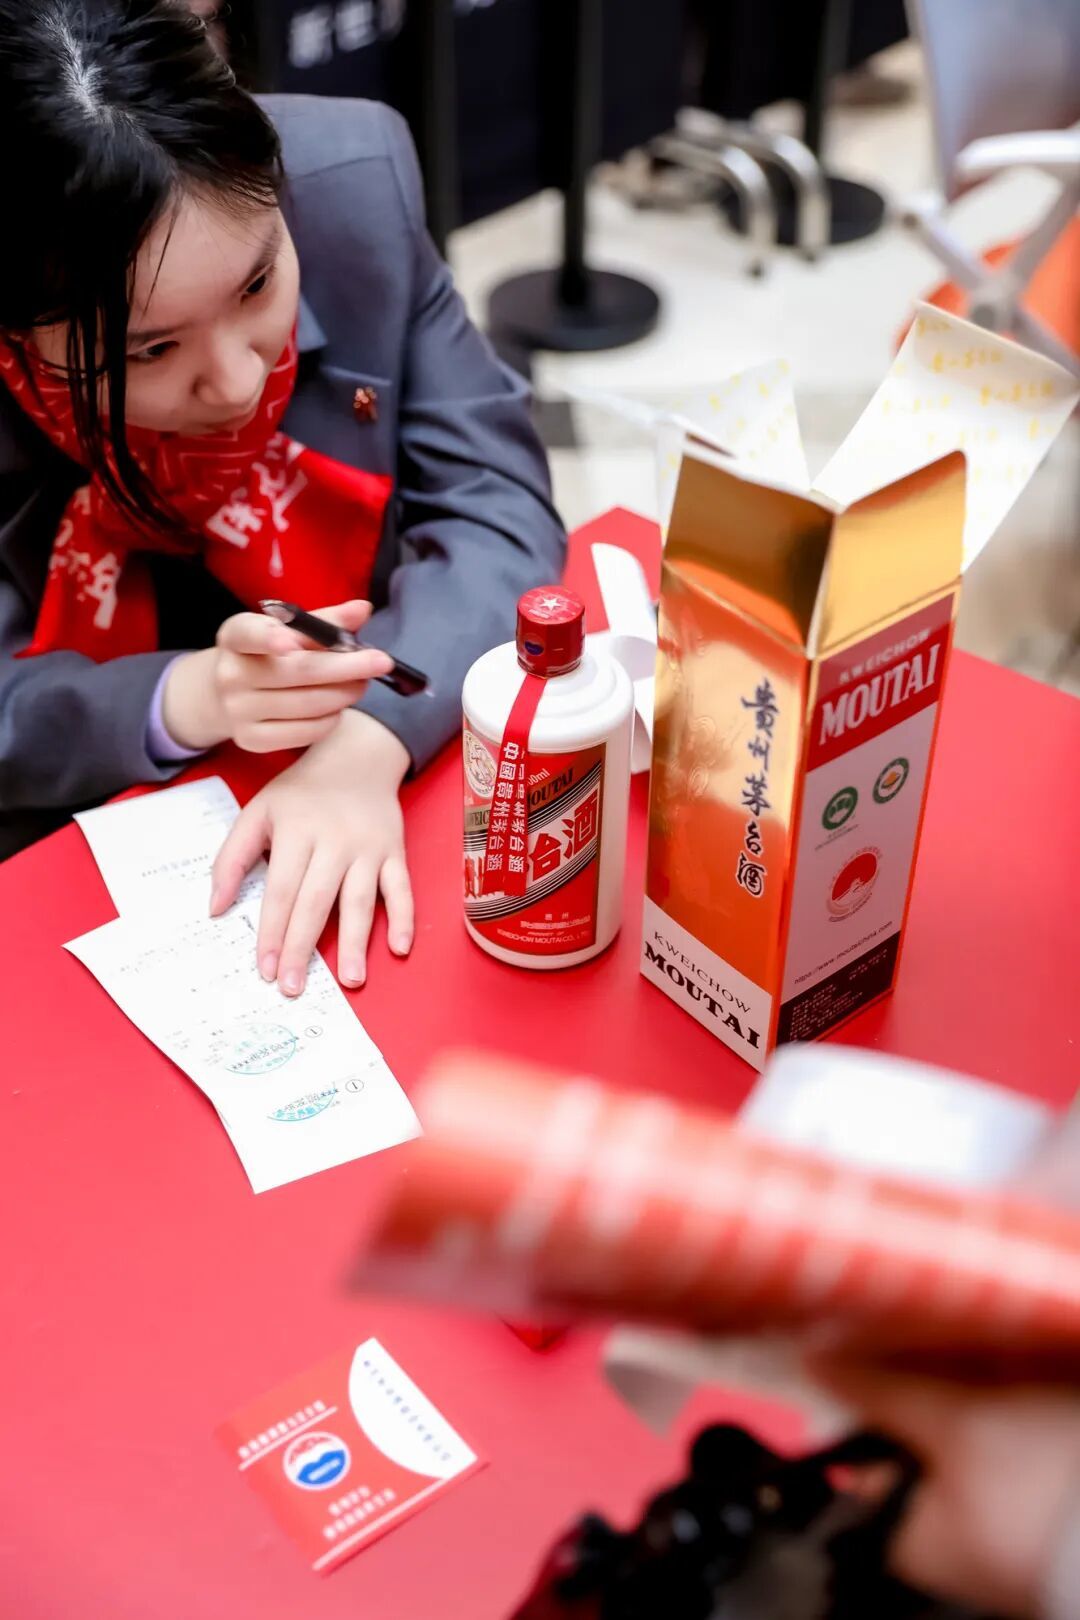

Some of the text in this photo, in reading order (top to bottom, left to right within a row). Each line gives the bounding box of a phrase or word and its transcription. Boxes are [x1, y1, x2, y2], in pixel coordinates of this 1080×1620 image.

[819, 643, 941, 746] MOUTAI
[644, 940, 761, 1050] MOUTAI
[654, 931, 751, 1014] KWEICHOW
